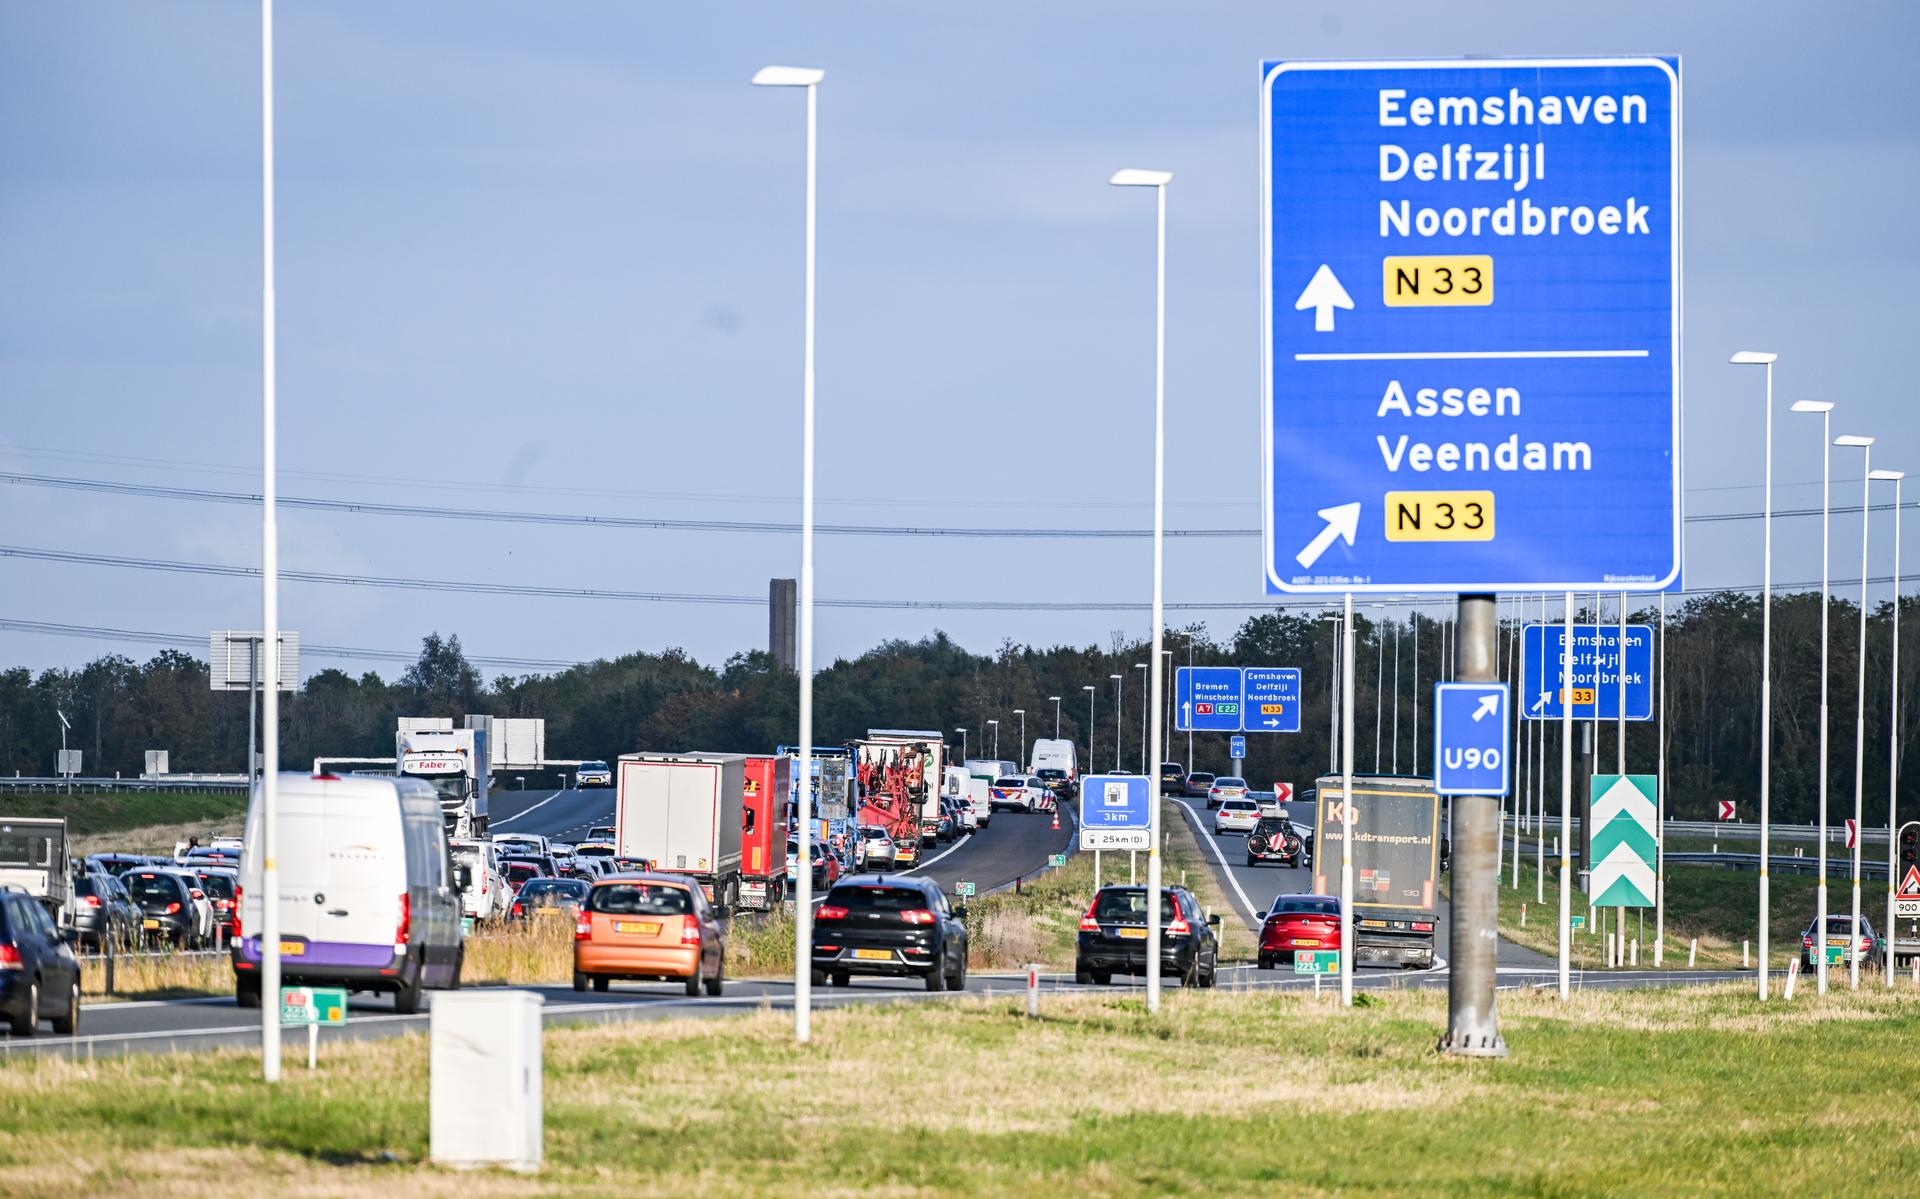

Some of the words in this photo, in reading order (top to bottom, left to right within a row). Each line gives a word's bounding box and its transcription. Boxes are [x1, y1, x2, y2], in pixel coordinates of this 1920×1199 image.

[1379, 88, 1647, 127] Eemshaven
[1379, 143, 1545, 191] Delfzijl
[1379, 197, 1650, 237] Noordbroek
[1377, 380, 1521, 417] Assen
[1376, 433, 1592, 472] Veendam
[1247, 672, 1297, 680] Eemshaven
[1195, 682, 1229, 691] Bremen
[1256, 683, 1288, 692] Delfzijl
[1194, 693, 1239, 701] Winschoten
[1247, 693, 1297, 702] Noordbroek
[419, 761, 448, 769] Faber
[1444, 747, 1501, 771] U90
[1325, 831, 1431, 845] ww.kdtransport.nl
